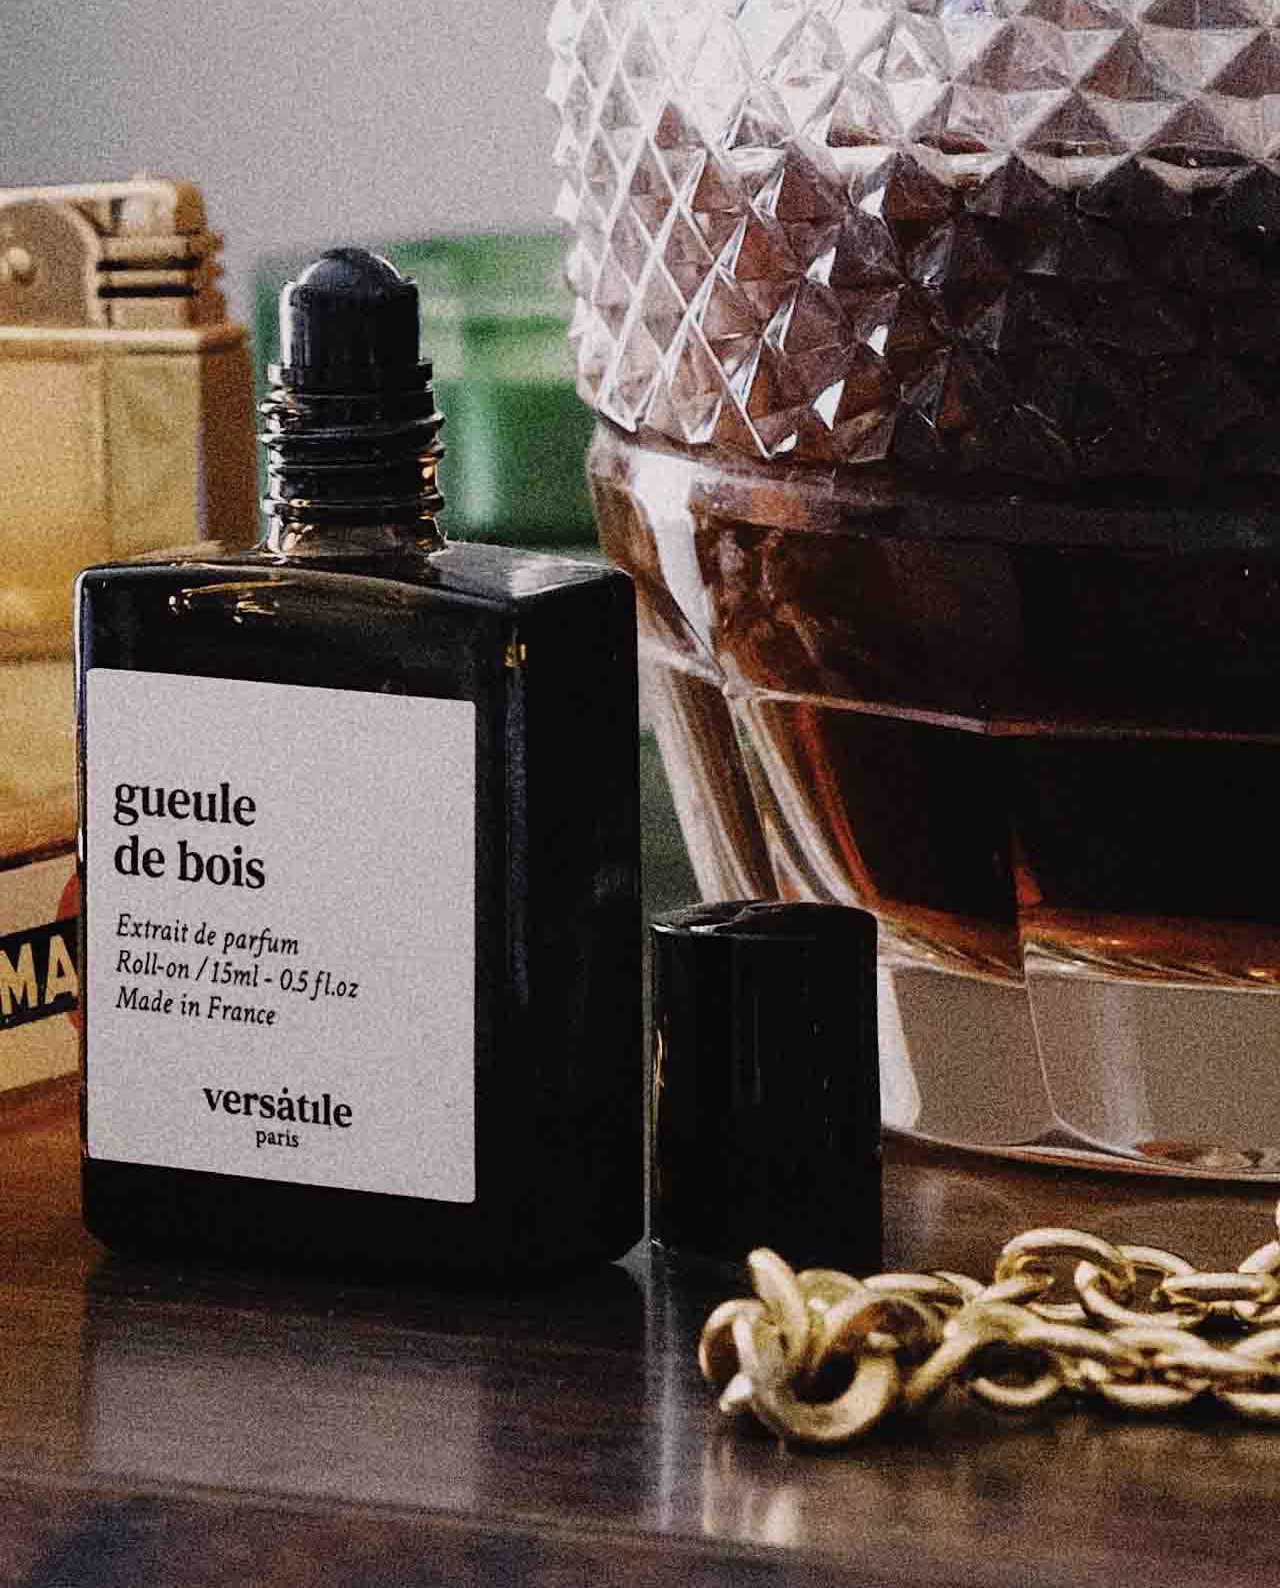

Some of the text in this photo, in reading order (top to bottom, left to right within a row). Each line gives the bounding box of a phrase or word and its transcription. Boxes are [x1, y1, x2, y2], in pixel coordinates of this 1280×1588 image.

[113, 782, 257, 827] gueule
[113, 835, 266, 890] de bois
[115, 913, 300, 959] Extrait de parfum
[115, 949, 191, 980] Roll-on
[279, 968, 310, 994] 0.5
[309, 970, 361, 1002] fl.oz
[115, 985, 277, 1026] Made in France
[255, 1129, 300, 1150] paris
